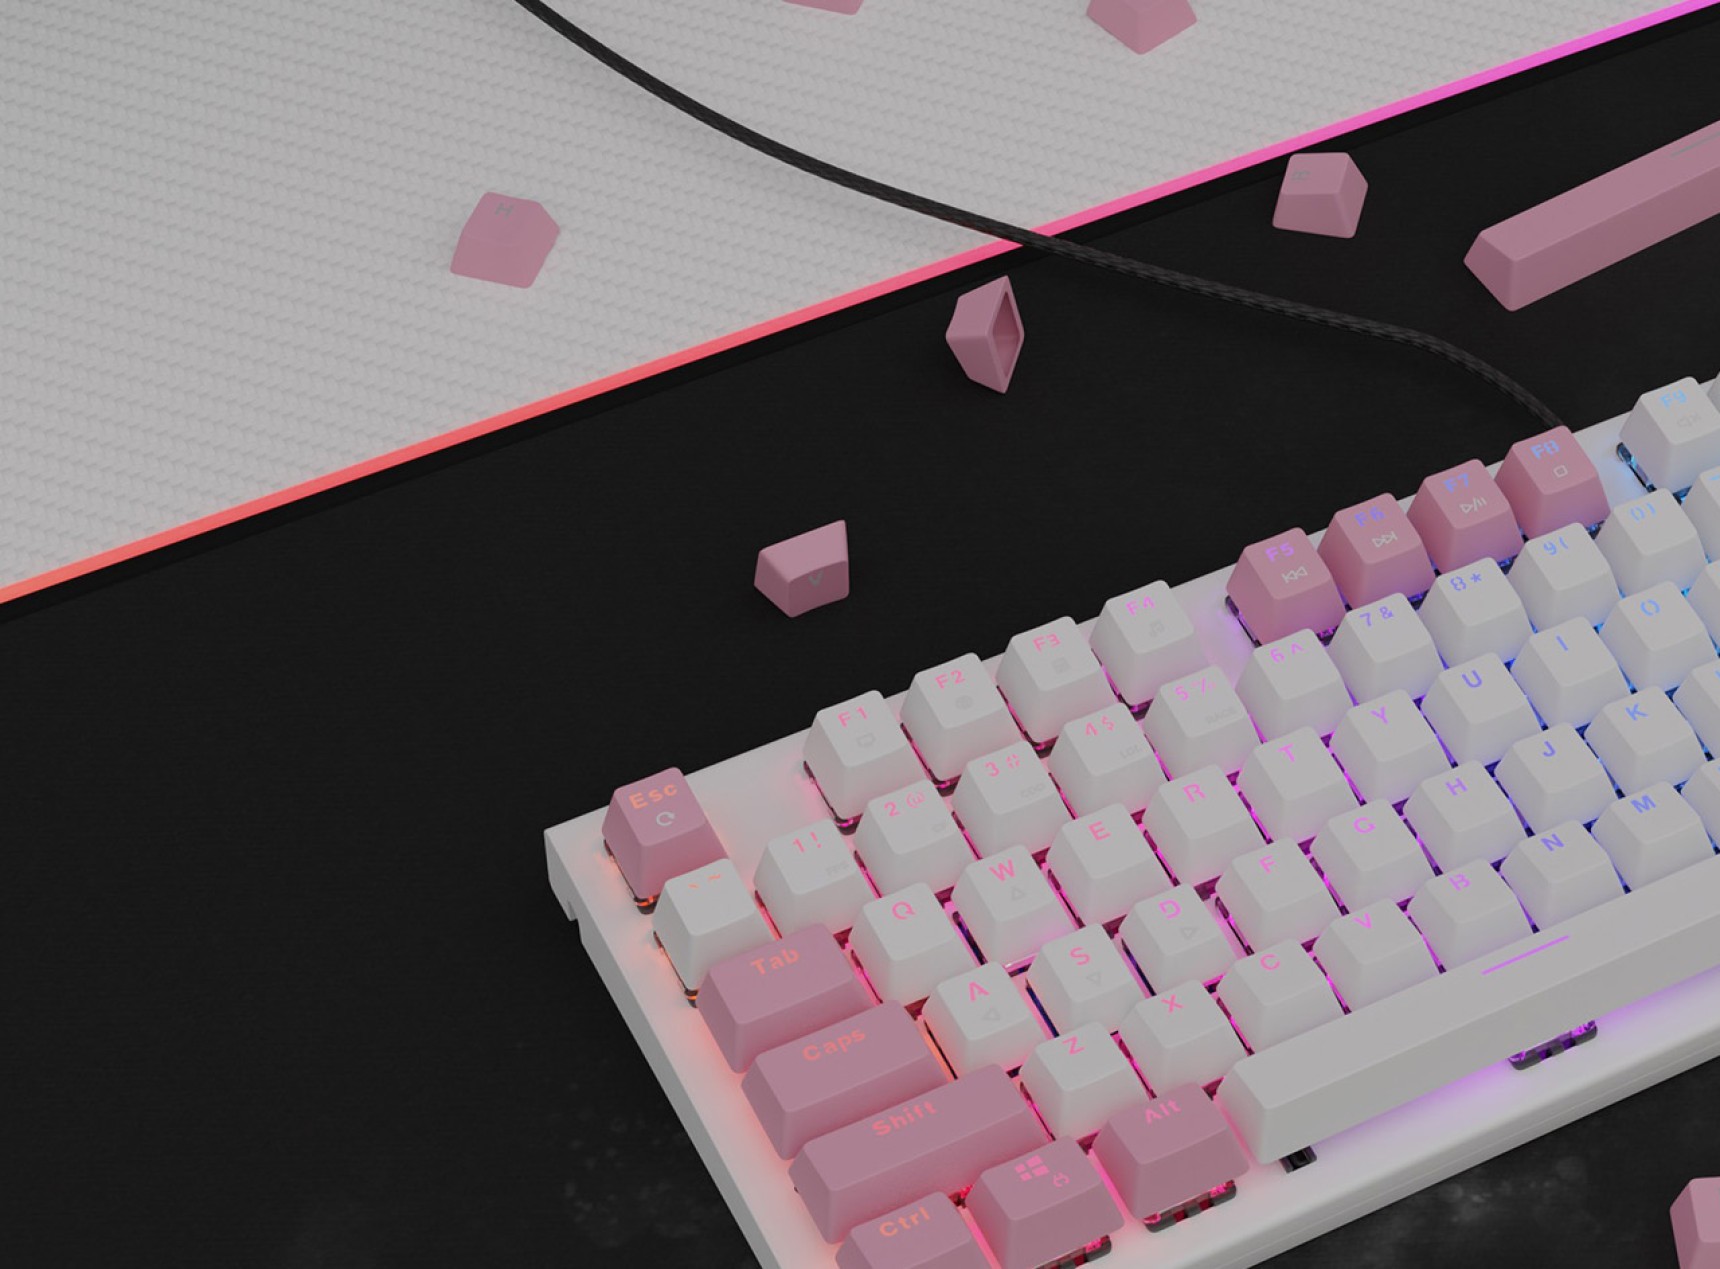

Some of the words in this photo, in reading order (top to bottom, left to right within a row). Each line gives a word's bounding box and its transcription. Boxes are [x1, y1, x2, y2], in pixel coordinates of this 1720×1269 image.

[1530, 440, 1560, 460] F8
[1443, 473, 1471, 494] F7
[1353, 506, 1386, 528] F6
[1264, 542, 1296, 564] F5
[1125, 595, 1156, 617] F4
[1640, 598, 1661, 617] O
[1032, 633, 1062, 653] F3
[1554, 634, 1570, 652] I
[934, 669, 967, 690] F2
[1461, 669, 1485, 690] U
[837, 706, 870, 728] F1
[1369, 706, 1389, 726] Y
[1625, 703, 1649, 722] K
[1277, 743, 1296, 762] T
[1542, 740, 1557, 758] J
[627, 783, 678, 810] Esc
[1182, 783, 1206, 802] R
[1445, 776, 1469, 797] H
[1630, 794, 1657, 814] M
[1088, 821, 1111, 842] E
[1353, 817, 1376, 834] G
[1540, 833, 1565, 852] N
[989, 858, 1017, 882] W
[1258, 855, 1277, 874] F
[1448, 873, 1472, 892] B
[892, 902, 917, 920] Q
[1158, 899, 1182, 919] D
[1353, 913, 1373, 930] V
[750, 947, 800, 976] Tab
[1068, 946, 1091, 966] S
[1260, 954, 1281, 971] C
[968, 981, 991, 1002] A
[1161, 993, 1184, 1014] X
[801, 1027, 867, 1062] Caps
[1062, 1036, 1086, 1055] Z
[870, 1100, 939, 1138] Shift
[1143, 1098, 1183, 1126] Alt
[878, 1205, 933, 1238] Ctrl
